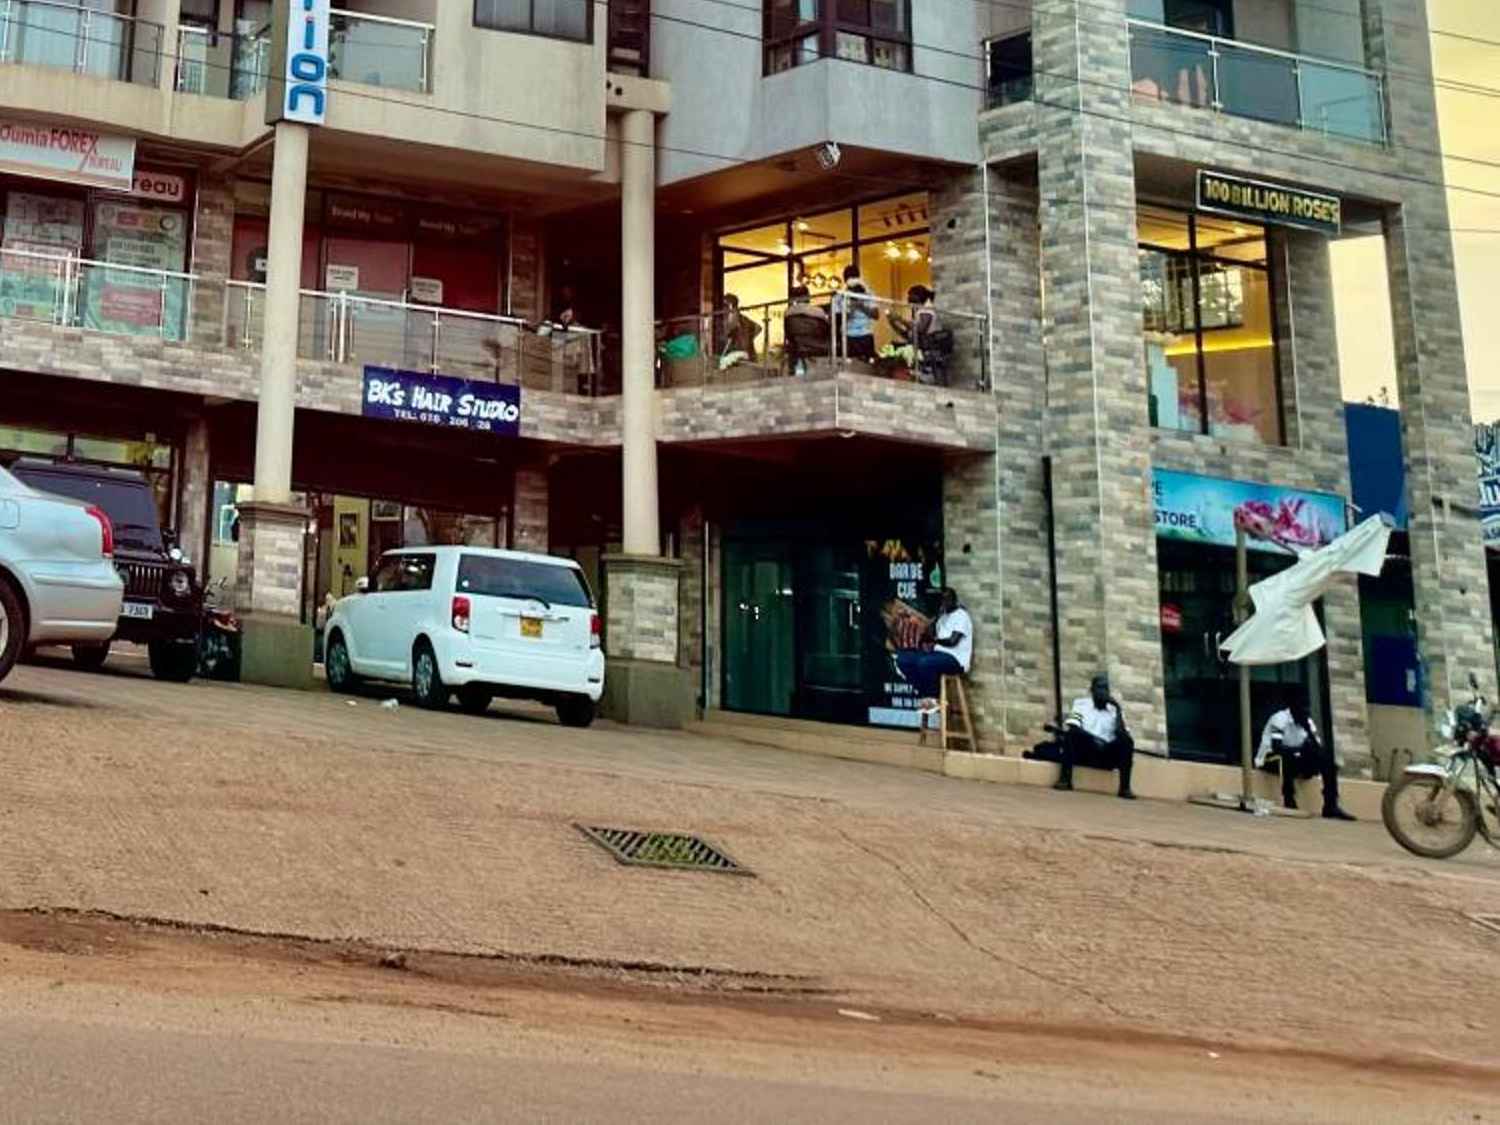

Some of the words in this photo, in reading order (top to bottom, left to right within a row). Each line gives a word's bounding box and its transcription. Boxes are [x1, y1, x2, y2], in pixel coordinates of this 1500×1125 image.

[51, 128, 100, 159] FOREX
[1205, 178, 1229, 202] 100
[1231, 186, 1290, 214] BILLION
[1292, 196, 1339, 224] ROSES
[1154, 509, 1197, 528] STORE
